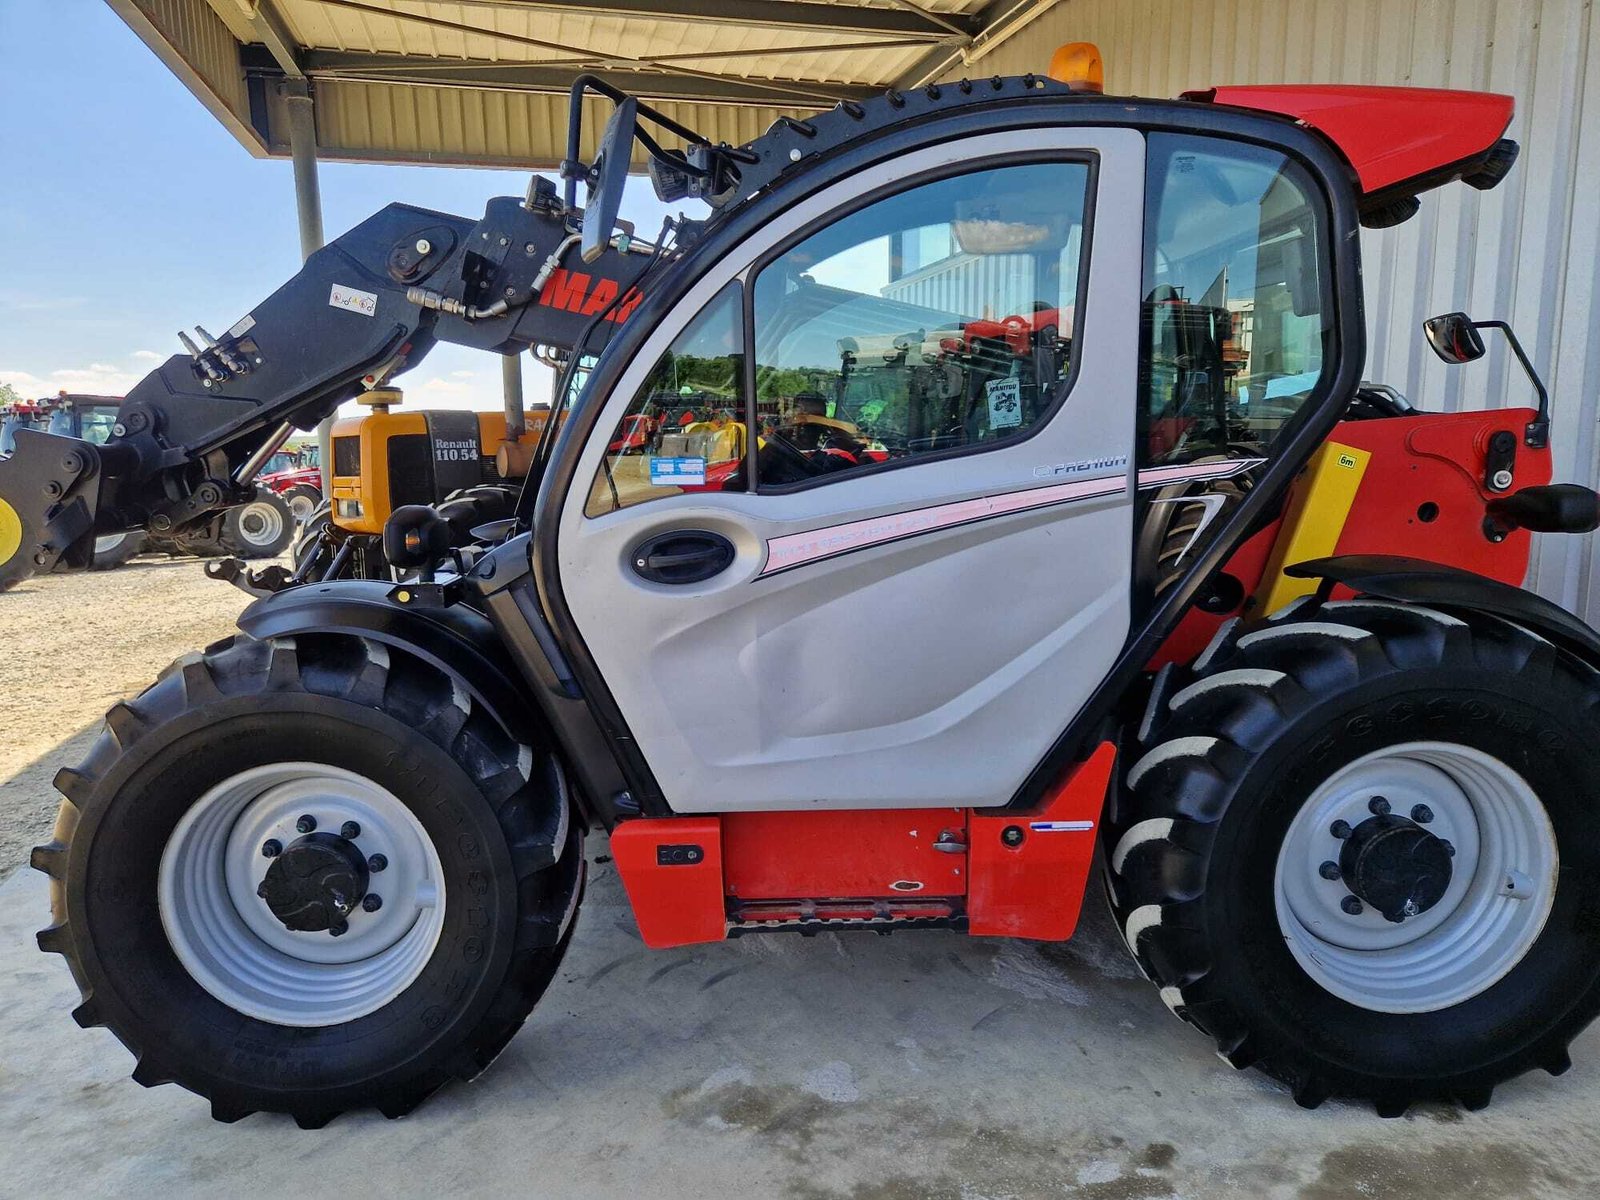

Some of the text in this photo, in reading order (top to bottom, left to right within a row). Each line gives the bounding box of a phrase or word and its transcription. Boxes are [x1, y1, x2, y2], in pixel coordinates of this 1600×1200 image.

[435, 438, 477, 449] Renault
[435, 449, 478, 461] 110.54
[1054, 454, 1128, 475] PREMIUM
[1340, 456, 1354, 467] 6m
